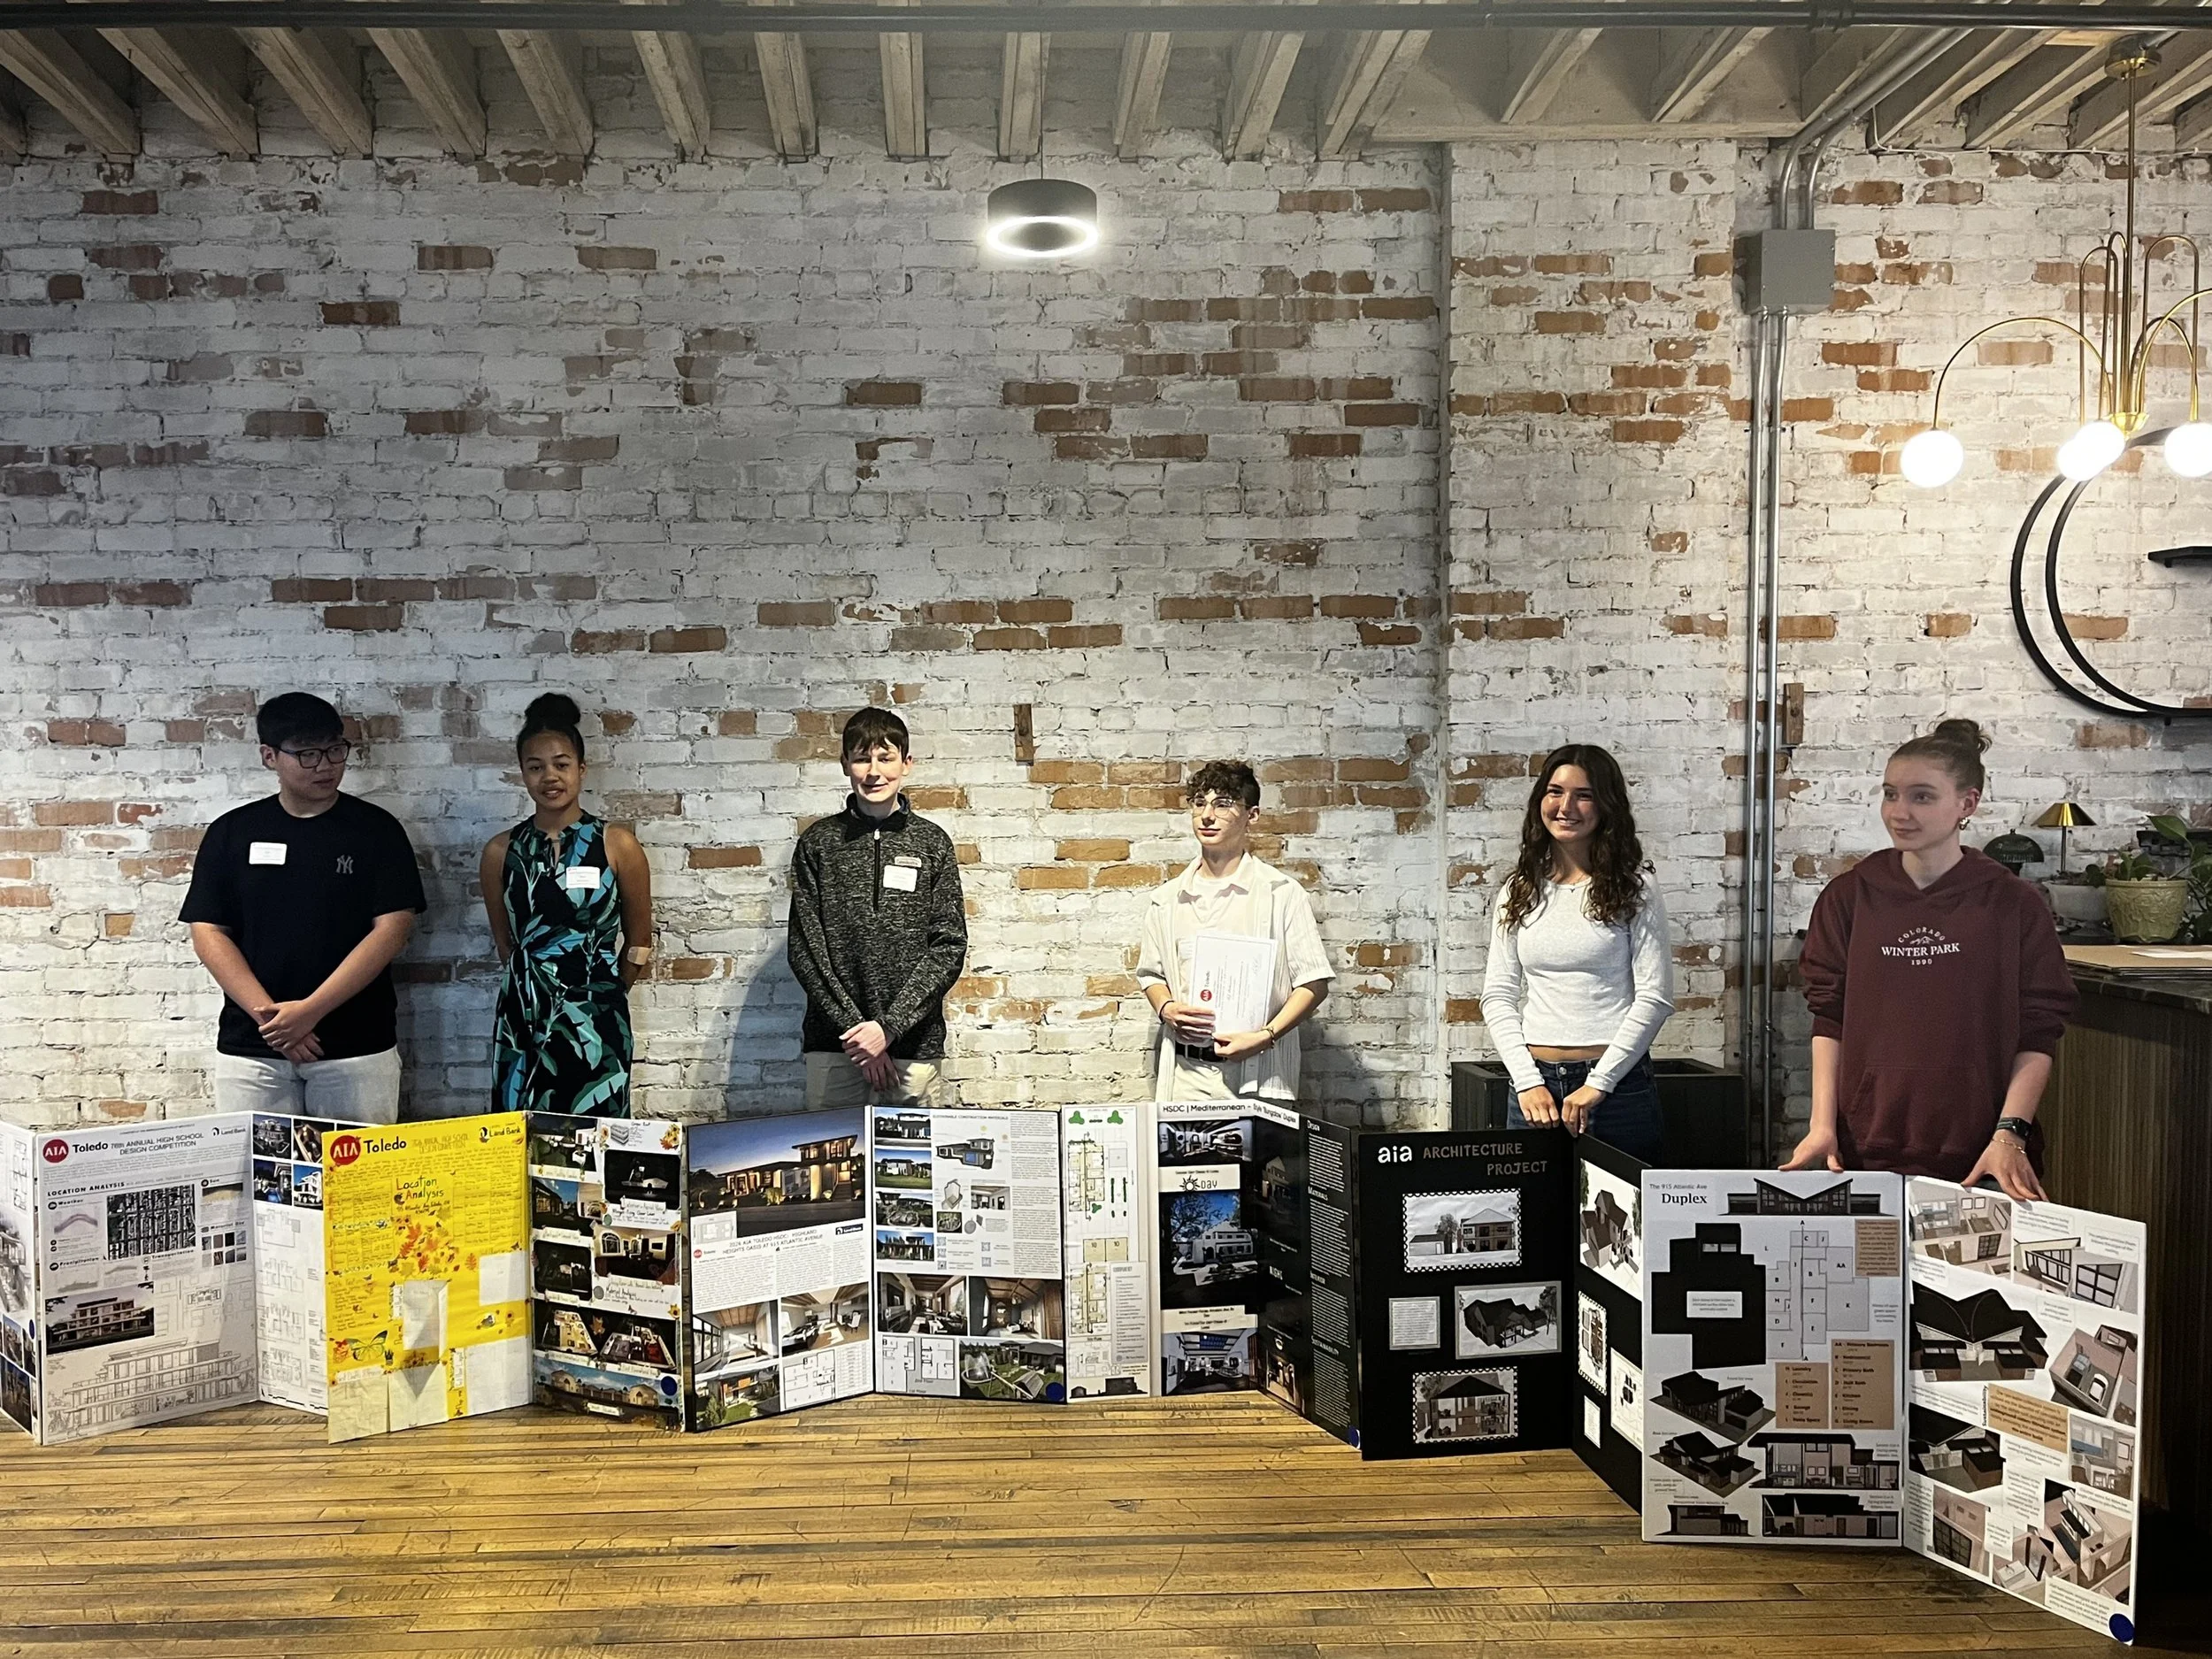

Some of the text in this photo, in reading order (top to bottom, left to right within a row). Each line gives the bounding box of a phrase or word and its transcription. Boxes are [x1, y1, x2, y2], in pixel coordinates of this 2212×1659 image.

[1898, 926, 1945, 943] COLORADO
[1881, 942, 1961, 956] WINTER PARK
[1191, 1103, 1246, 1112] Mediterranean
[489, 1126, 521, 1138] Land Bank
[119, 1140, 196, 1156] DESIGN COMPETITION
[127, 1139, 155, 1148] ANNUAL
[175, 1133, 204, 1141] SCHOOL
[332, 1142, 359, 1159] AIA
[364, 1135, 407, 1155] Toledo
[45, 1141, 108, 1157] AIA Toledo
[1377, 1142, 1523, 1164] aia ARCHITECTURE
[1486, 1161, 1548, 1176] PROJECT
[48, 1181, 125, 1196] LOCATION ANALYSIS
[396, 1175, 437, 1190] Location
[406, 1188, 444, 1202] Analysis
[1662, 1193, 1708, 1206] Duplex
